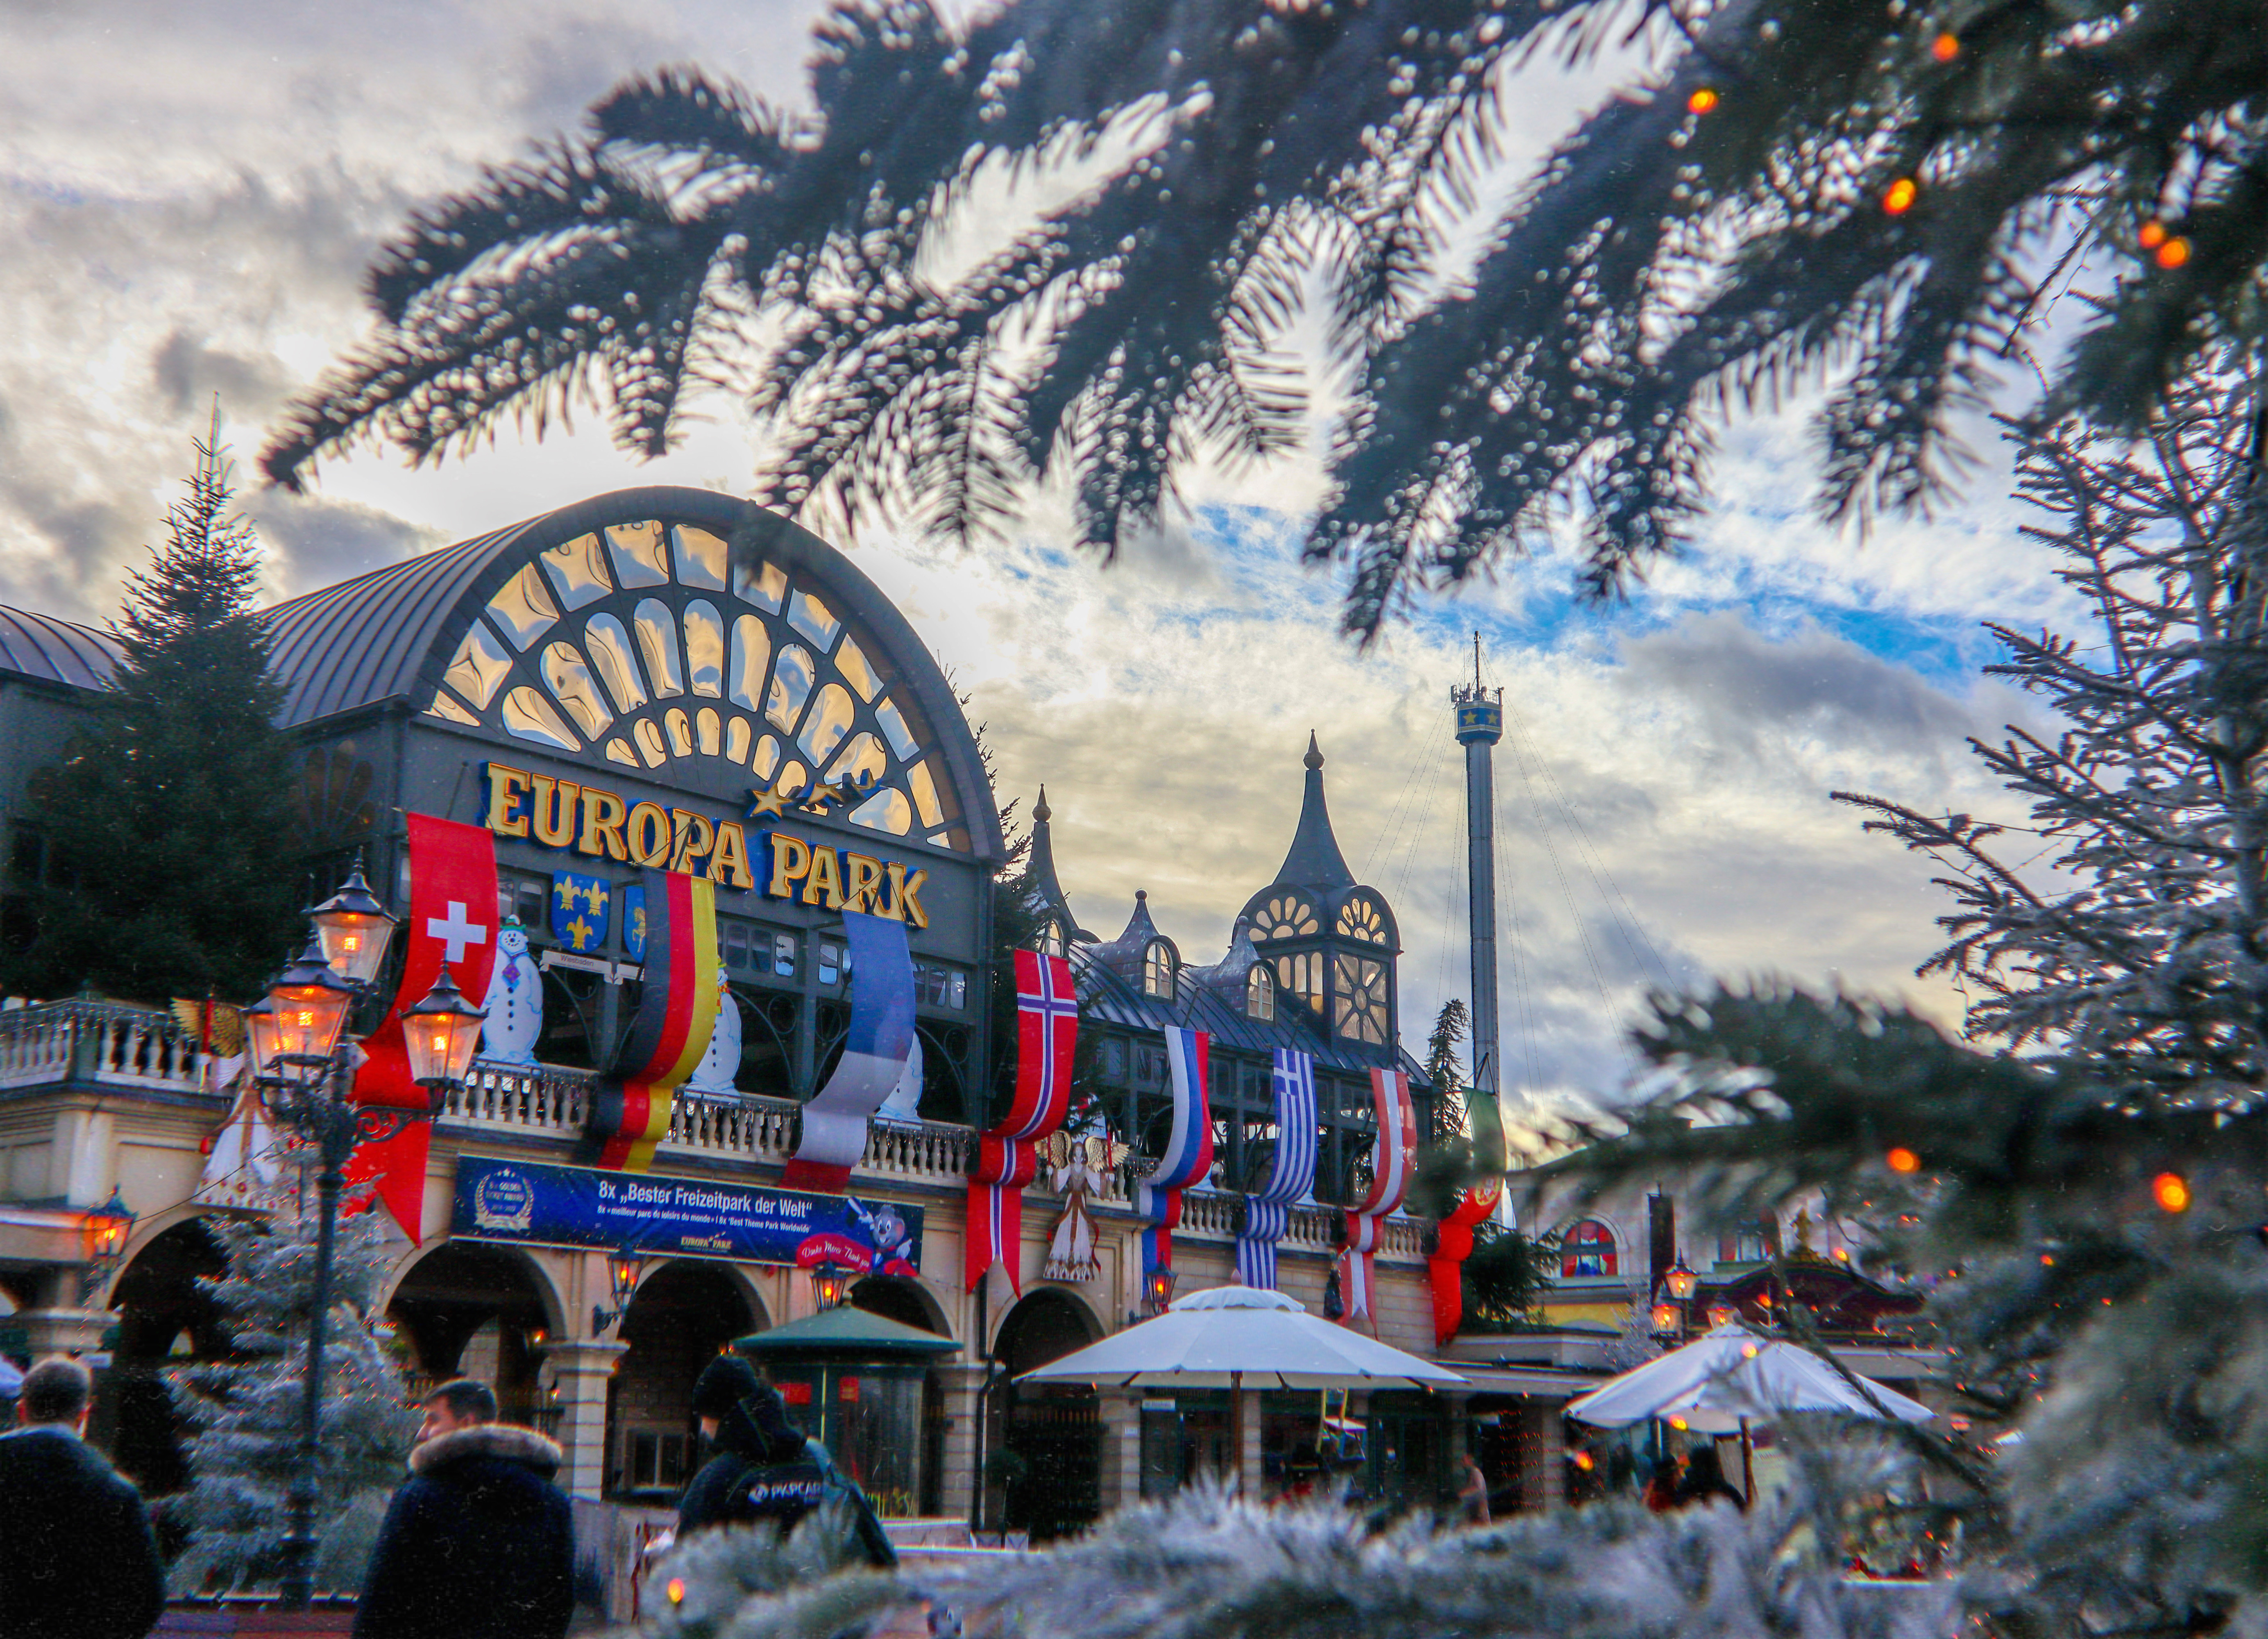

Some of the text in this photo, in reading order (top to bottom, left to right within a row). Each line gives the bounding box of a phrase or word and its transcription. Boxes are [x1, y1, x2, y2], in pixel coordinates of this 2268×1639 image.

[483, 761, 929, 929] EUROPA PARK
[560, 954, 594, 967] Wiesbaden
[598, 1180, 617, 1199] 8x
[619, 1182, 672, 1204] „Bester
[675, 1187, 751, 1213] Freizeitpark
[755, 1196, 776, 1215] der
[597, 1204, 606, 1214] 8x
[637, 1209, 652, 1219] parc
[653, 1209, 661, 1219] de
[661, 1210, 680, 1221] loisirs
[681, 1212, 690, 1221] du
[719, 1216, 727, 1225] 8x
[744, 1218, 764, 1229] Theme
[765, 1220, 779, 1230] Park
[680, 1236, 709, 1248] EUROPA
[712, 1239, 733, 1250] PARK
[801, 1240, 870, 1268] Danke Merci Thank you
